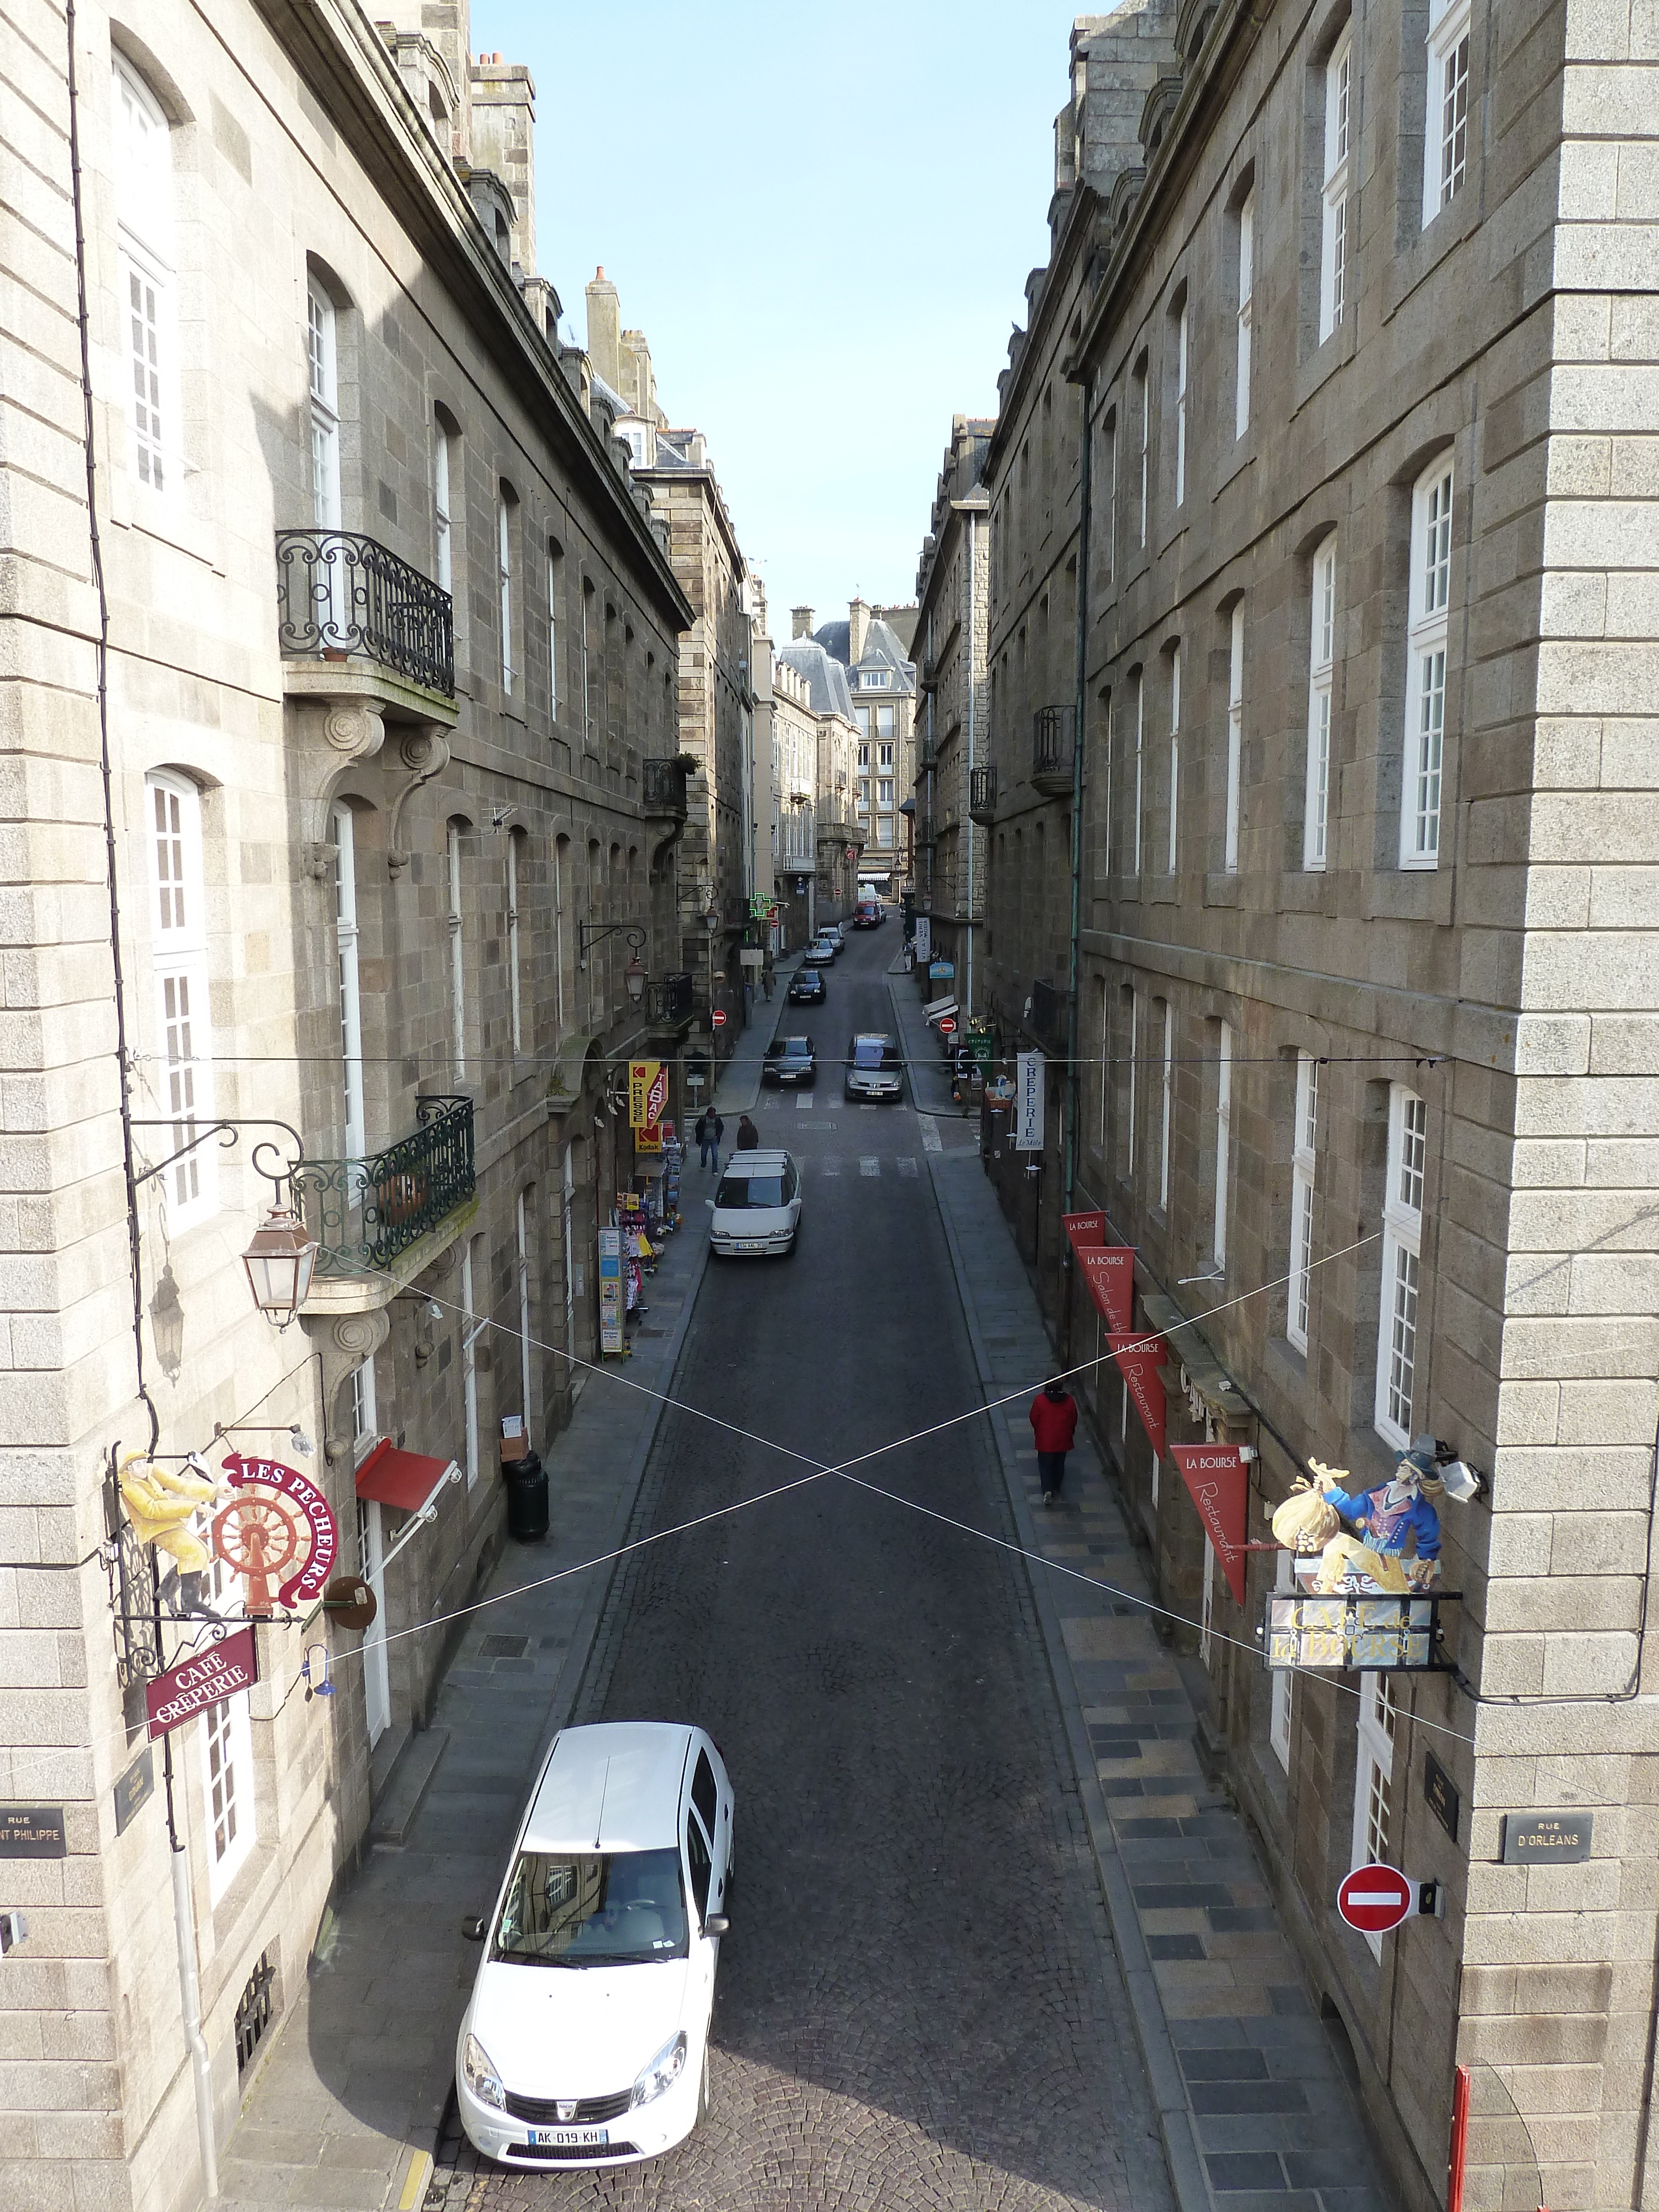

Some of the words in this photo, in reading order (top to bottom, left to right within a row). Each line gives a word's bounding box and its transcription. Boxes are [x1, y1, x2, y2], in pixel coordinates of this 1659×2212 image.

[633, 1082, 643, 1122] PRESSE
[648, 1073, 665, 1119] TABAC
[1070, 1222, 1076, 1230] LA
[1077, 1220, 1098, 1229] BOURSE
[1087, 1256, 1095, 1265] LA
[1097, 1256, 1124, 1265] BOURSE
[1093, 1271, 1114, 1305] Salon
[1107, 1307, 1122, 1320] de
[1113, 1321, 1128, 1333] th
[1128, 1343, 1159, 1353] BOURSE
[1124, 1363, 1160, 1429] Restaurant
[1186, 1458, 1197, 1469] LA
[1200, 1457, 1237, 1468] BOURSE
[241, 1463, 285, 1483] LES
[287, 1477, 333, 1589] PECHEURS
[1194, 1481, 1239, 1563] Restaurant
[1384, 1610, 1411, 1630] de
[1272, 1636, 1296, 1658] la
[1307, 1630, 1424, 1658] BOURSE
[175, 1651, 227, 1689] CAFÉ
[156, 1665, 248, 1724] CRÊPERIE
[14, 1829, 60, 1840] PHILIPPE
[1517, 1834, 1579, 1846] D'ORLEANS
[538, 2132, 552, 2143] AK
[557, 2132, 578, 2143] 019
[583, 2131, 598, 2143] KH
